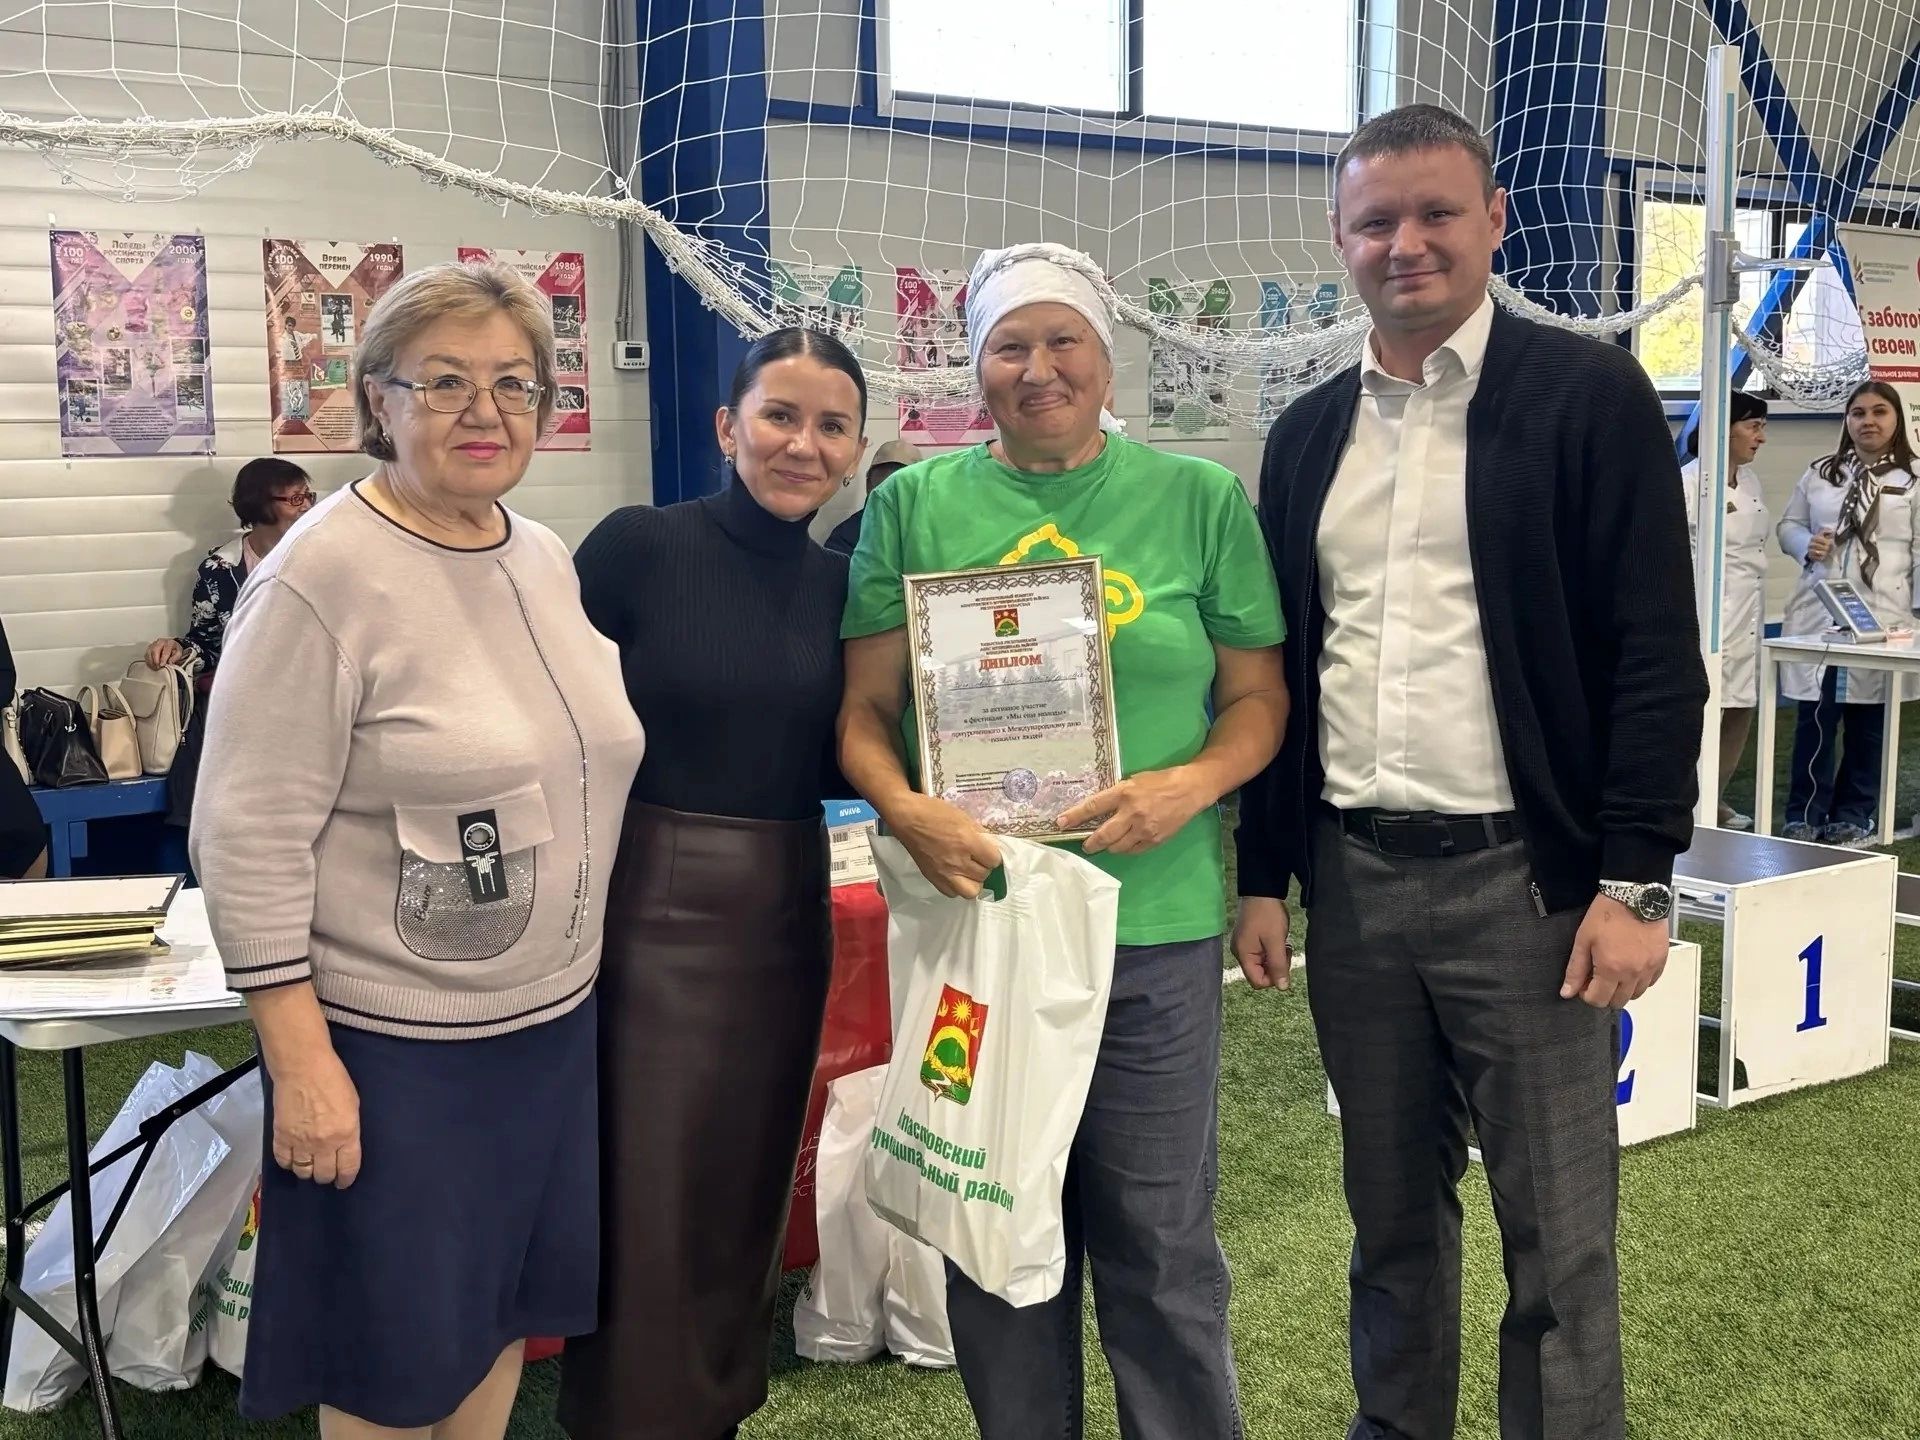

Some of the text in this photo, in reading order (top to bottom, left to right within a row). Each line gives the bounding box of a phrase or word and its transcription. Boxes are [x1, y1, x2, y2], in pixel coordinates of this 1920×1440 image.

[274, 254, 294, 265] 100
[1867, 305, 1920, 329] забото
[979, 654, 1043, 672] ДИПЛОМ
[1796, 934, 1828, 1033] 1
[963, 1179, 1014, 1213] район
